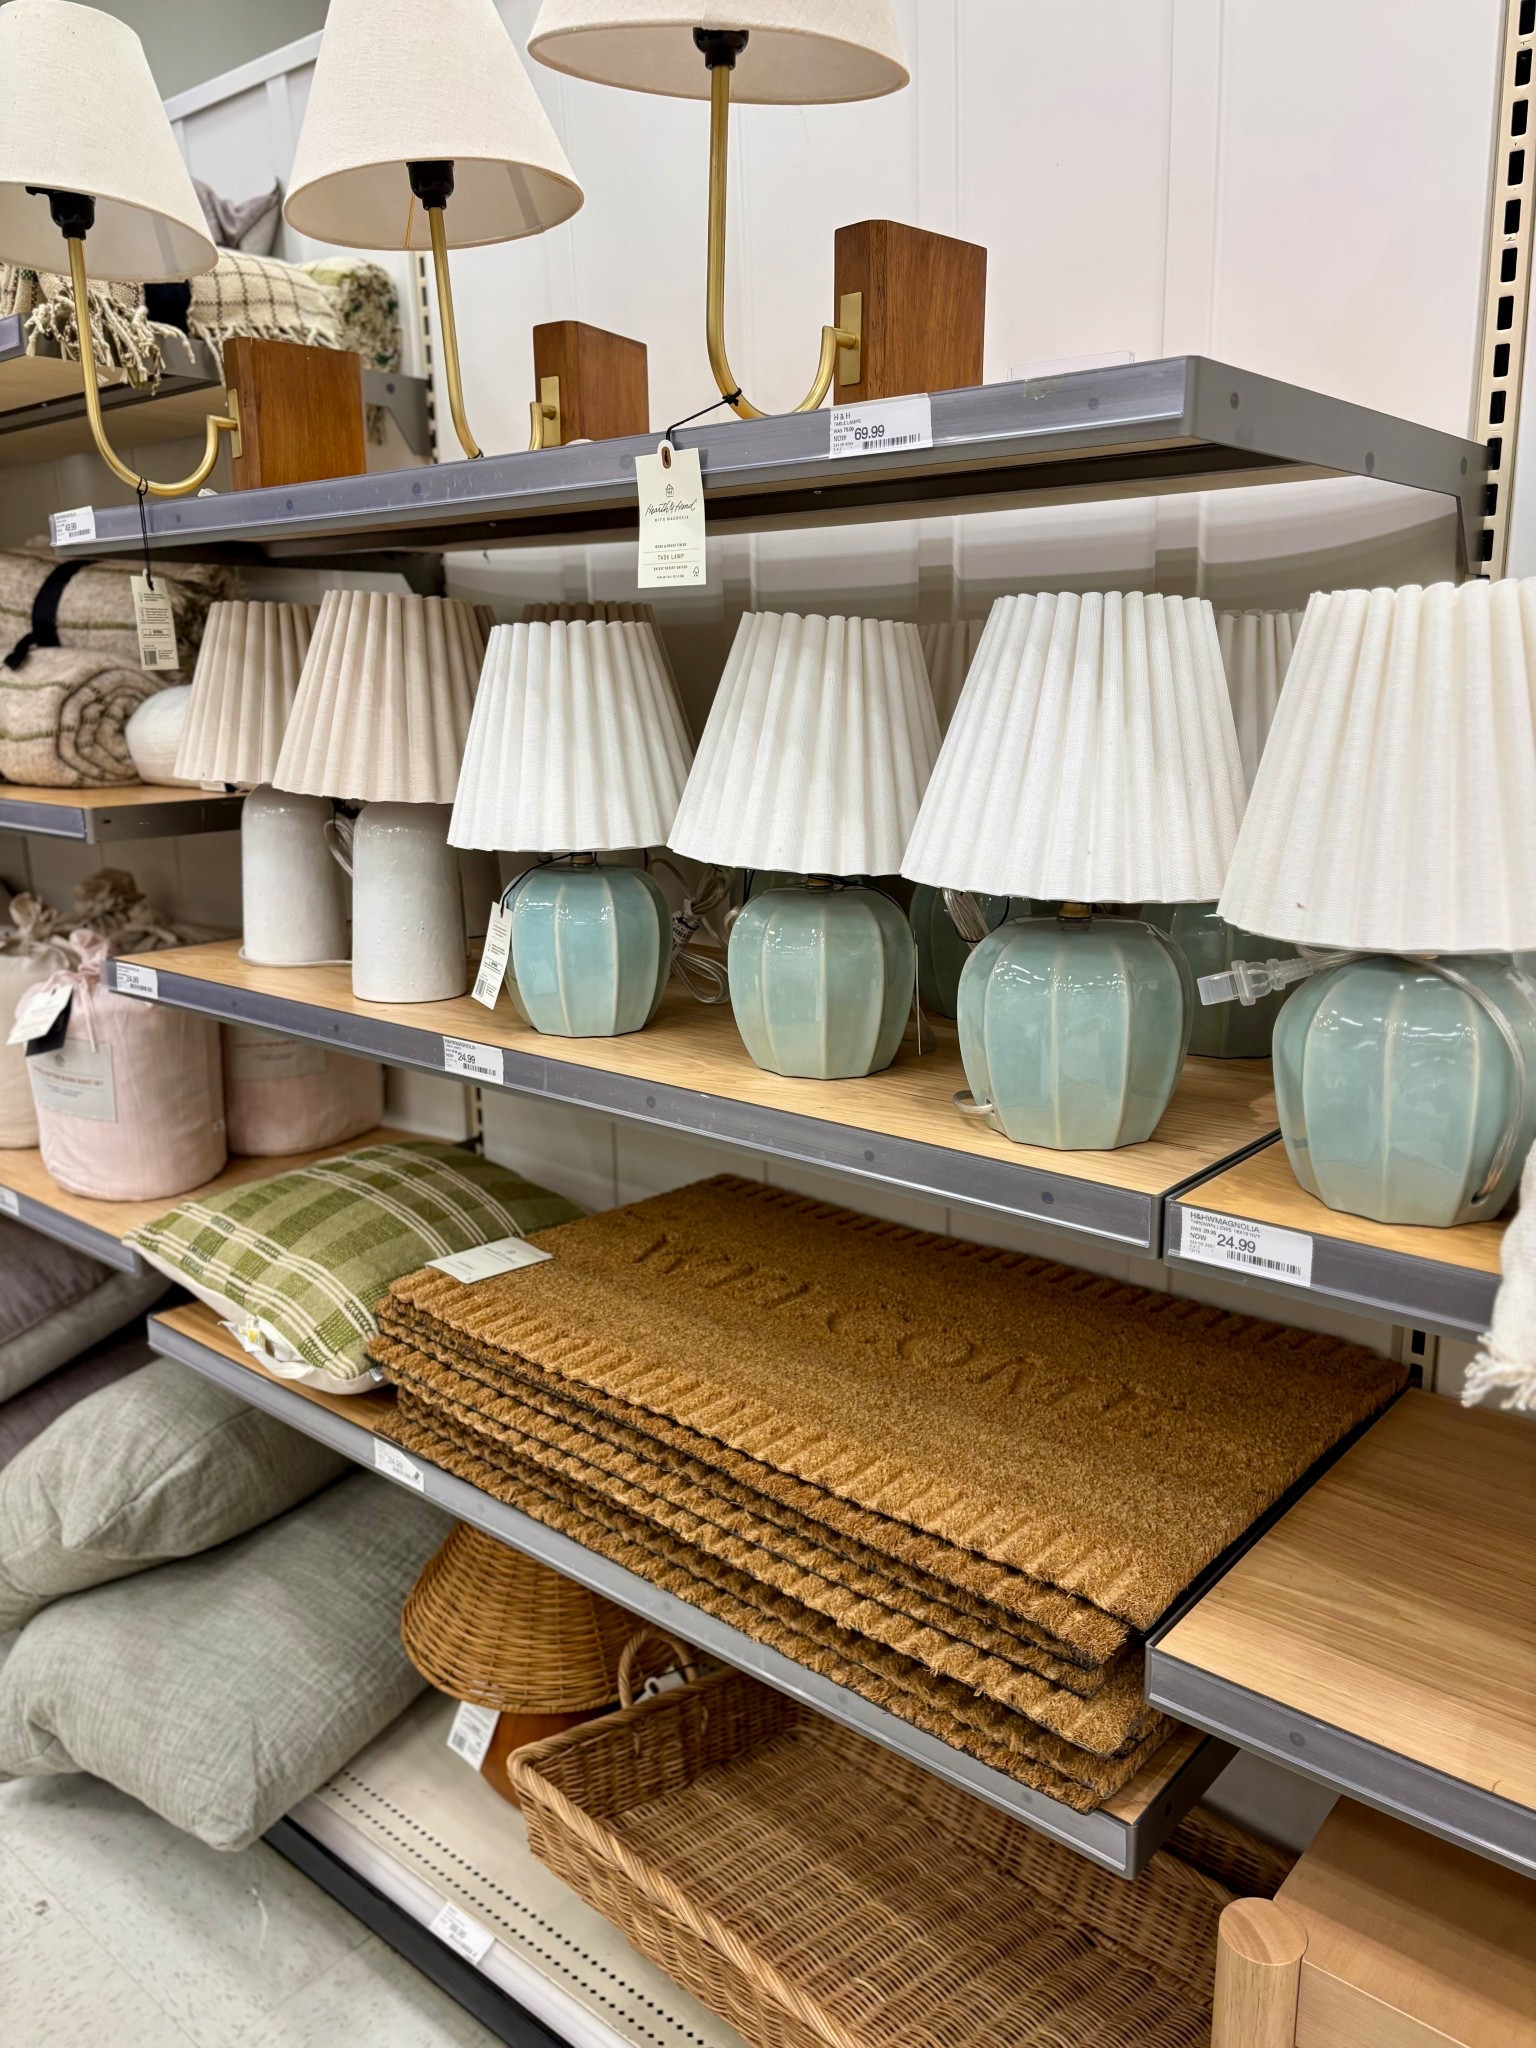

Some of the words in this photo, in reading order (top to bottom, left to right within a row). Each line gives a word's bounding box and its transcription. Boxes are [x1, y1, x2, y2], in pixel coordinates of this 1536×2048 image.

[854, 424, 885, 440] 69.99
[645, 500, 671, 517] Hearth
[674, 498, 698, 512] Hand
[458, 1052, 476, 1064] 24.99
[1190, 1211, 1260, 1234] H&HWMAGNOLIA
[1189, 1232, 1207, 1241] NOW
[1216, 1233, 1256, 1254] 24.99
